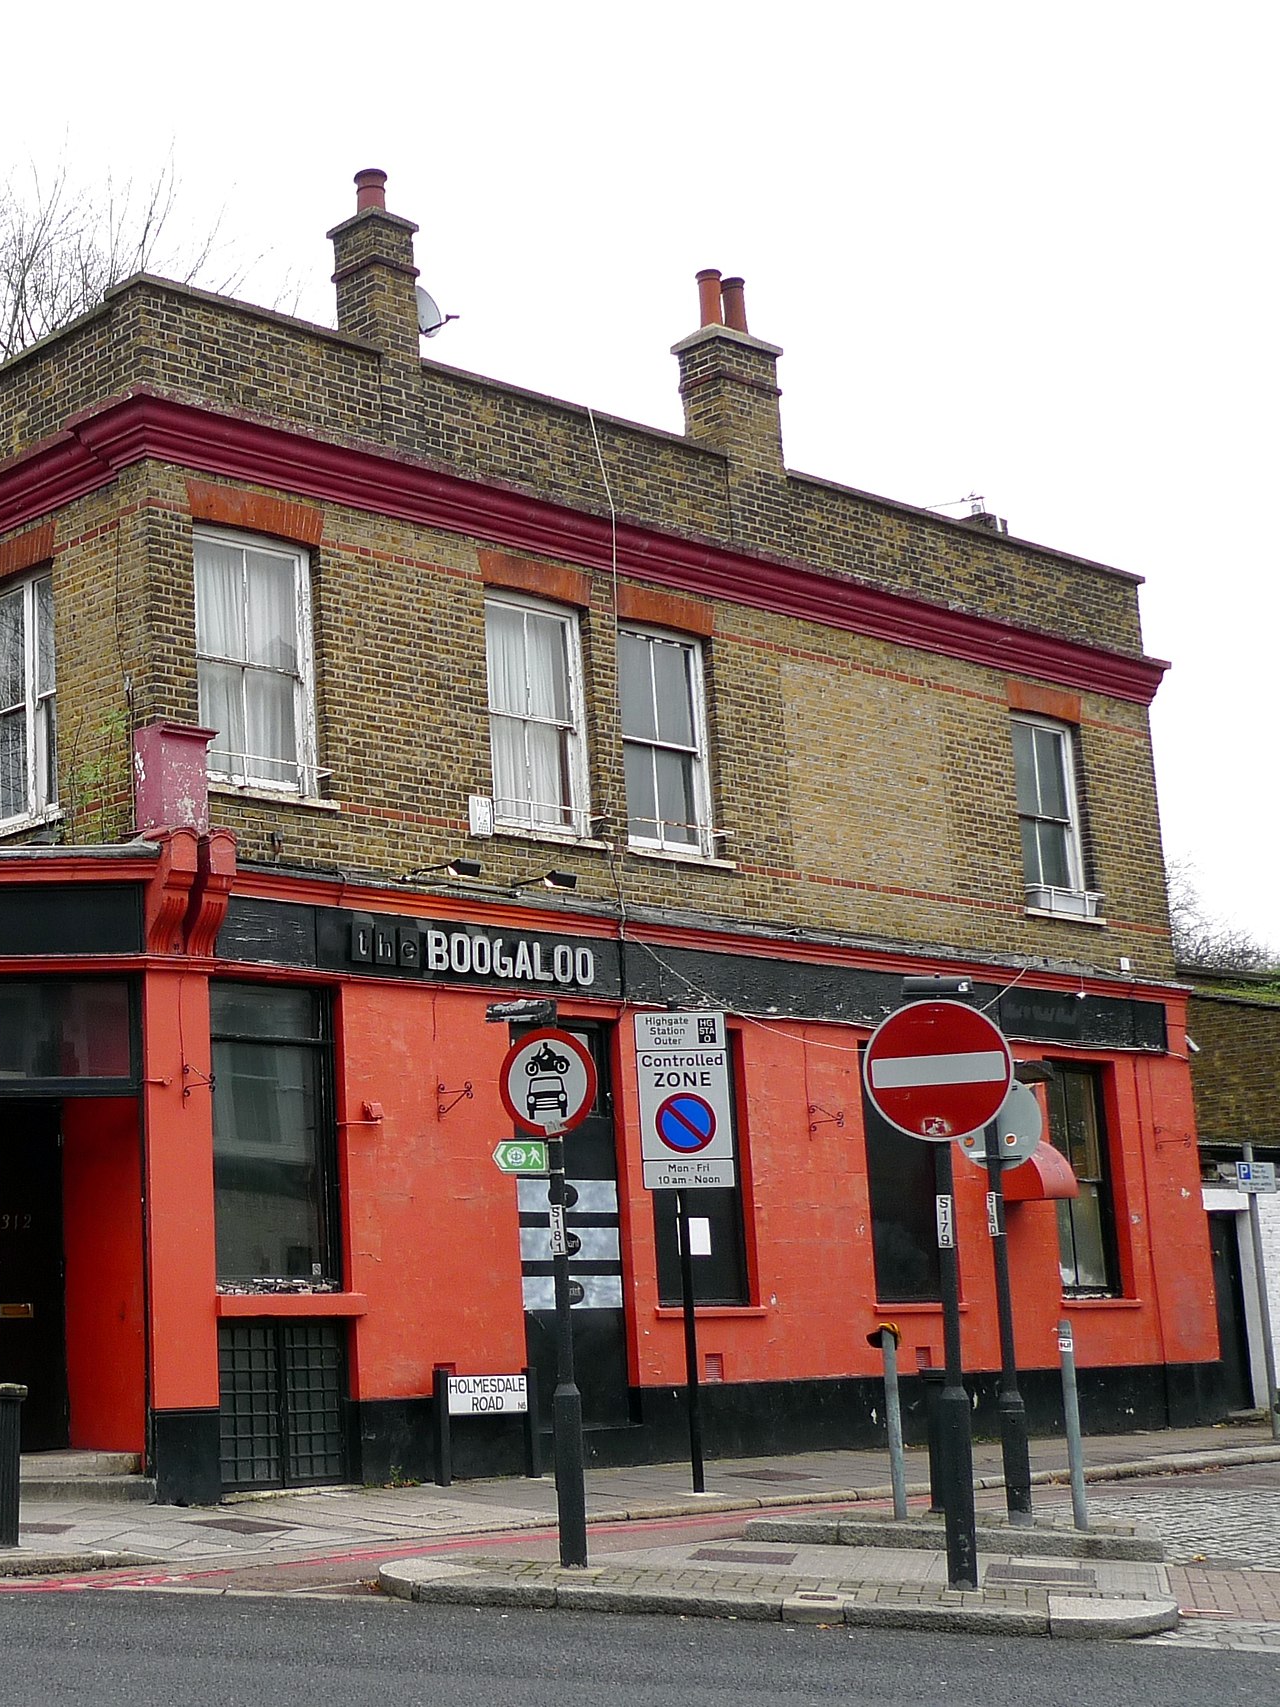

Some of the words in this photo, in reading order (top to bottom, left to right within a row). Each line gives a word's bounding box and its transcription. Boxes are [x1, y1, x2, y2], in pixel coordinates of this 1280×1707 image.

[427, 929, 595, 986] BOOGALOO
[645, 1017, 689, 1026] Highgate
[699, 1019, 714, 1027] HG
[649, 1027, 686, 1036] Station
[699, 1027, 715, 1035] STA
[654, 1036, 683, 1045] Outer
[641, 1053, 724, 1068] Controlled
[653, 1071, 712, 1088] ZONE
[668, 1164, 689, 1172] Mon
[696, 1163, 710, 1172] Fri
[1240, 1164, 1249, 1179] P
[694, 1175, 721, 1184] Noon
[1, 1214, 32, 1230] 312
[939, 1197, 950, 1246] S179
[551, 1206, 563, 1253] S181
[449, 1377, 526, 1394] HOLMESDALE
[471, 1395, 504, 1411] ROAD
